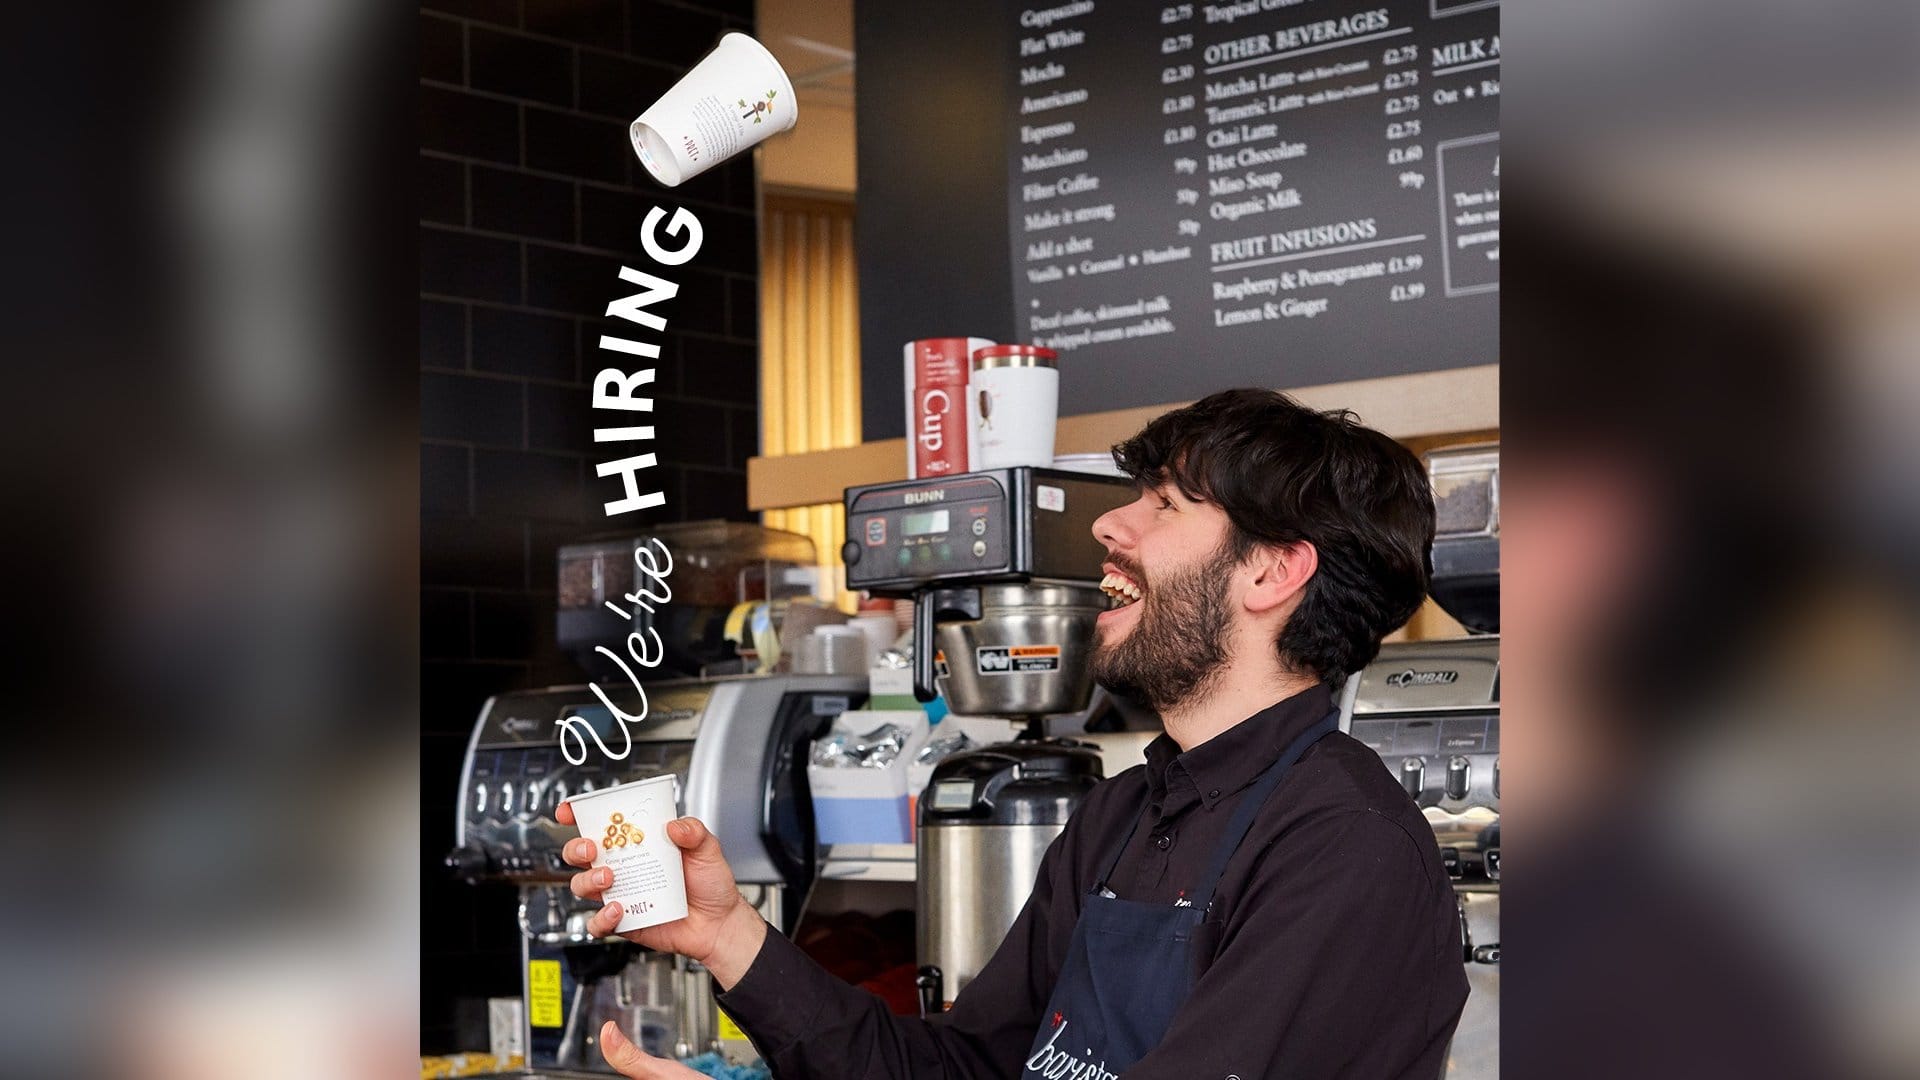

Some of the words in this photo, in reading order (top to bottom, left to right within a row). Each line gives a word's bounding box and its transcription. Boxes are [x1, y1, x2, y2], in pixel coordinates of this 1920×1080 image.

[1020, 0, 1095, 27] Cappuccino
[1020, 38, 1046, 56] Flat
[1046, 29, 1086, 49] White
[1204, 35, 1271, 64] OTHER
[1276, 8, 1389, 50] BEVERAGES
[1432, 38, 1486, 67] MILK
[1020, 62, 1065, 85] Mocha
[1205, 77, 1257, 101] Matcha
[1259, 72, 1296, 90] Latte
[1383, 45, 1418, 65] £2.75
[1020, 89, 1089, 114] Americano
[1205, 100, 1267, 125] Turmeric
[1268, 94, 1305, 113] Latte
[1384, 70, 1419, 90] £2.75
[1021, 121, 1075, 144] Espresso
[1206, 127, 1241, 148] Chai
[1241, 124, 1278, 142] Latte
[1385, 94, 1420, 115] £2.75
[1022, 148, 1088, 172] Macchiato
[1208, 154, 1237, 173] Hot
[1238, 141, 1307, 167] Chocolate
[1386, 119, 1422, 140] £2.75
[1023, 183, 1056, 202] Filter
[1057, 172, 1100, 196] Coffee
[1209, 174, 1245, 196] Miso
[1246, 171, 1283, 190] Soup
[1024, 210, 1060, 232] Make
[1062, 208, 1073, 225] it
[1074, 204, 1116, 222] strong
[1210, 195, 1266, 221] Organic
[1267, 188, 1302, 211] Milk
[1026, 239, 1054, 261] Add
[1055, 243, 1064, 256] a
[1065, 235, 1093, 253] shot
[1210, 235, 1268, 263] FRUIT
[1270, 217, 1377, 253] INFUSIONS
[1080, 254, 1125, 275] Caramel
[1212, 276, 1279, 301] Raspberry
[1281, 271, 1297, 290] &
[1298, 261, 1386, 287] Pomegranate
[1214, 308, 1263, 327] Lemon
[1263, 301, 1281, 320] &
[1280, 298, 1328, 318] Ginger
[918, 389, 951, 452] Cup
[904, 489, 945, 505] BUNN
[1399, 669, 1457, 689] CIMBALI
[630, 901, 649, 915] PRET
